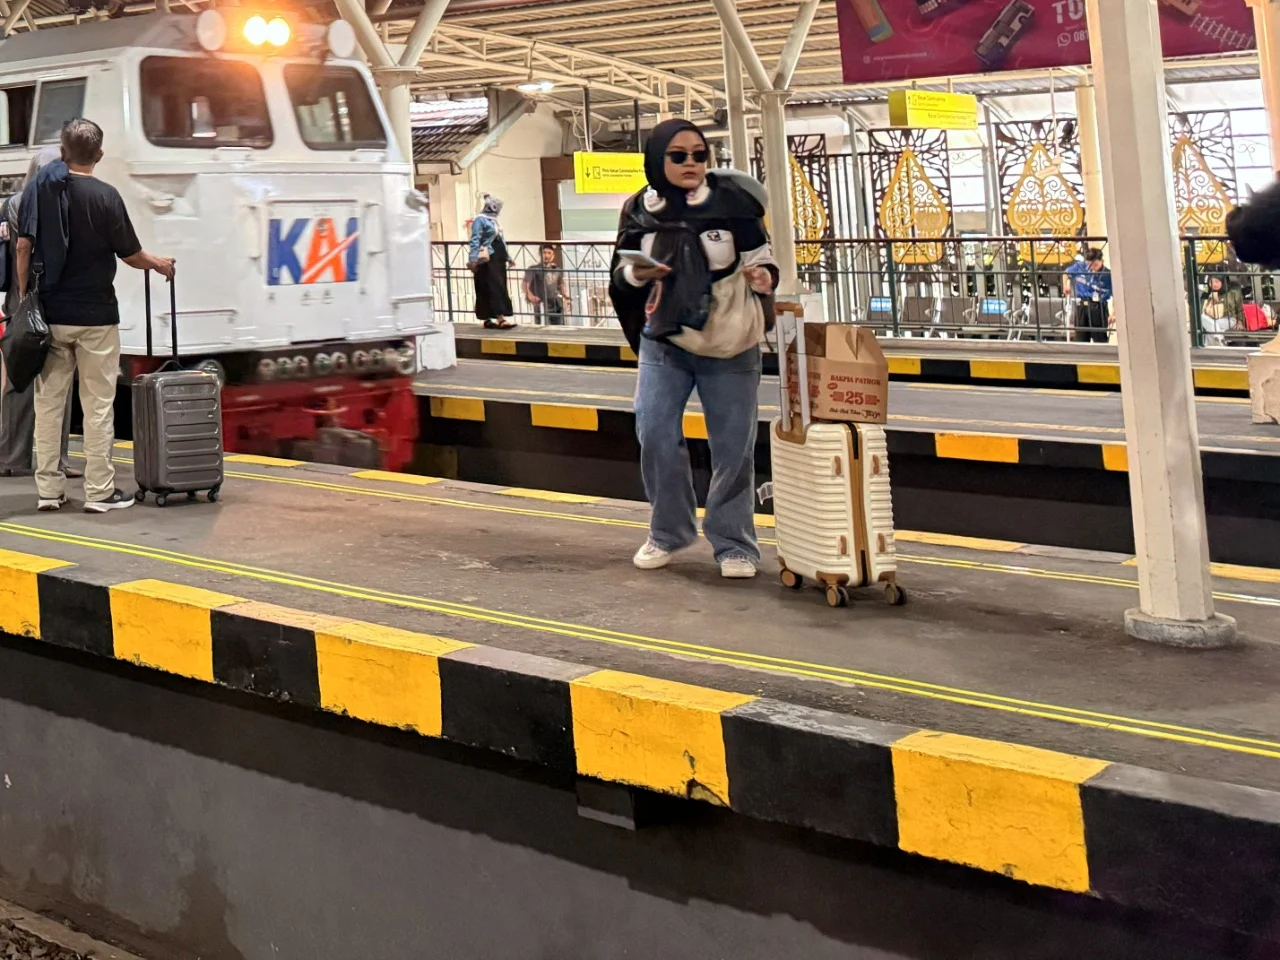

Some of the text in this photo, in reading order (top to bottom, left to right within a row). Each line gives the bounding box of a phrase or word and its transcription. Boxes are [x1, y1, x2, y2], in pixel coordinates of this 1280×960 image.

[267, 216, 360, 286] KAI
[830, 374, 854, 383] BAKPIA
[854, 376, 881, 386] PATHOK
[844, 390, 864, 406] 25
